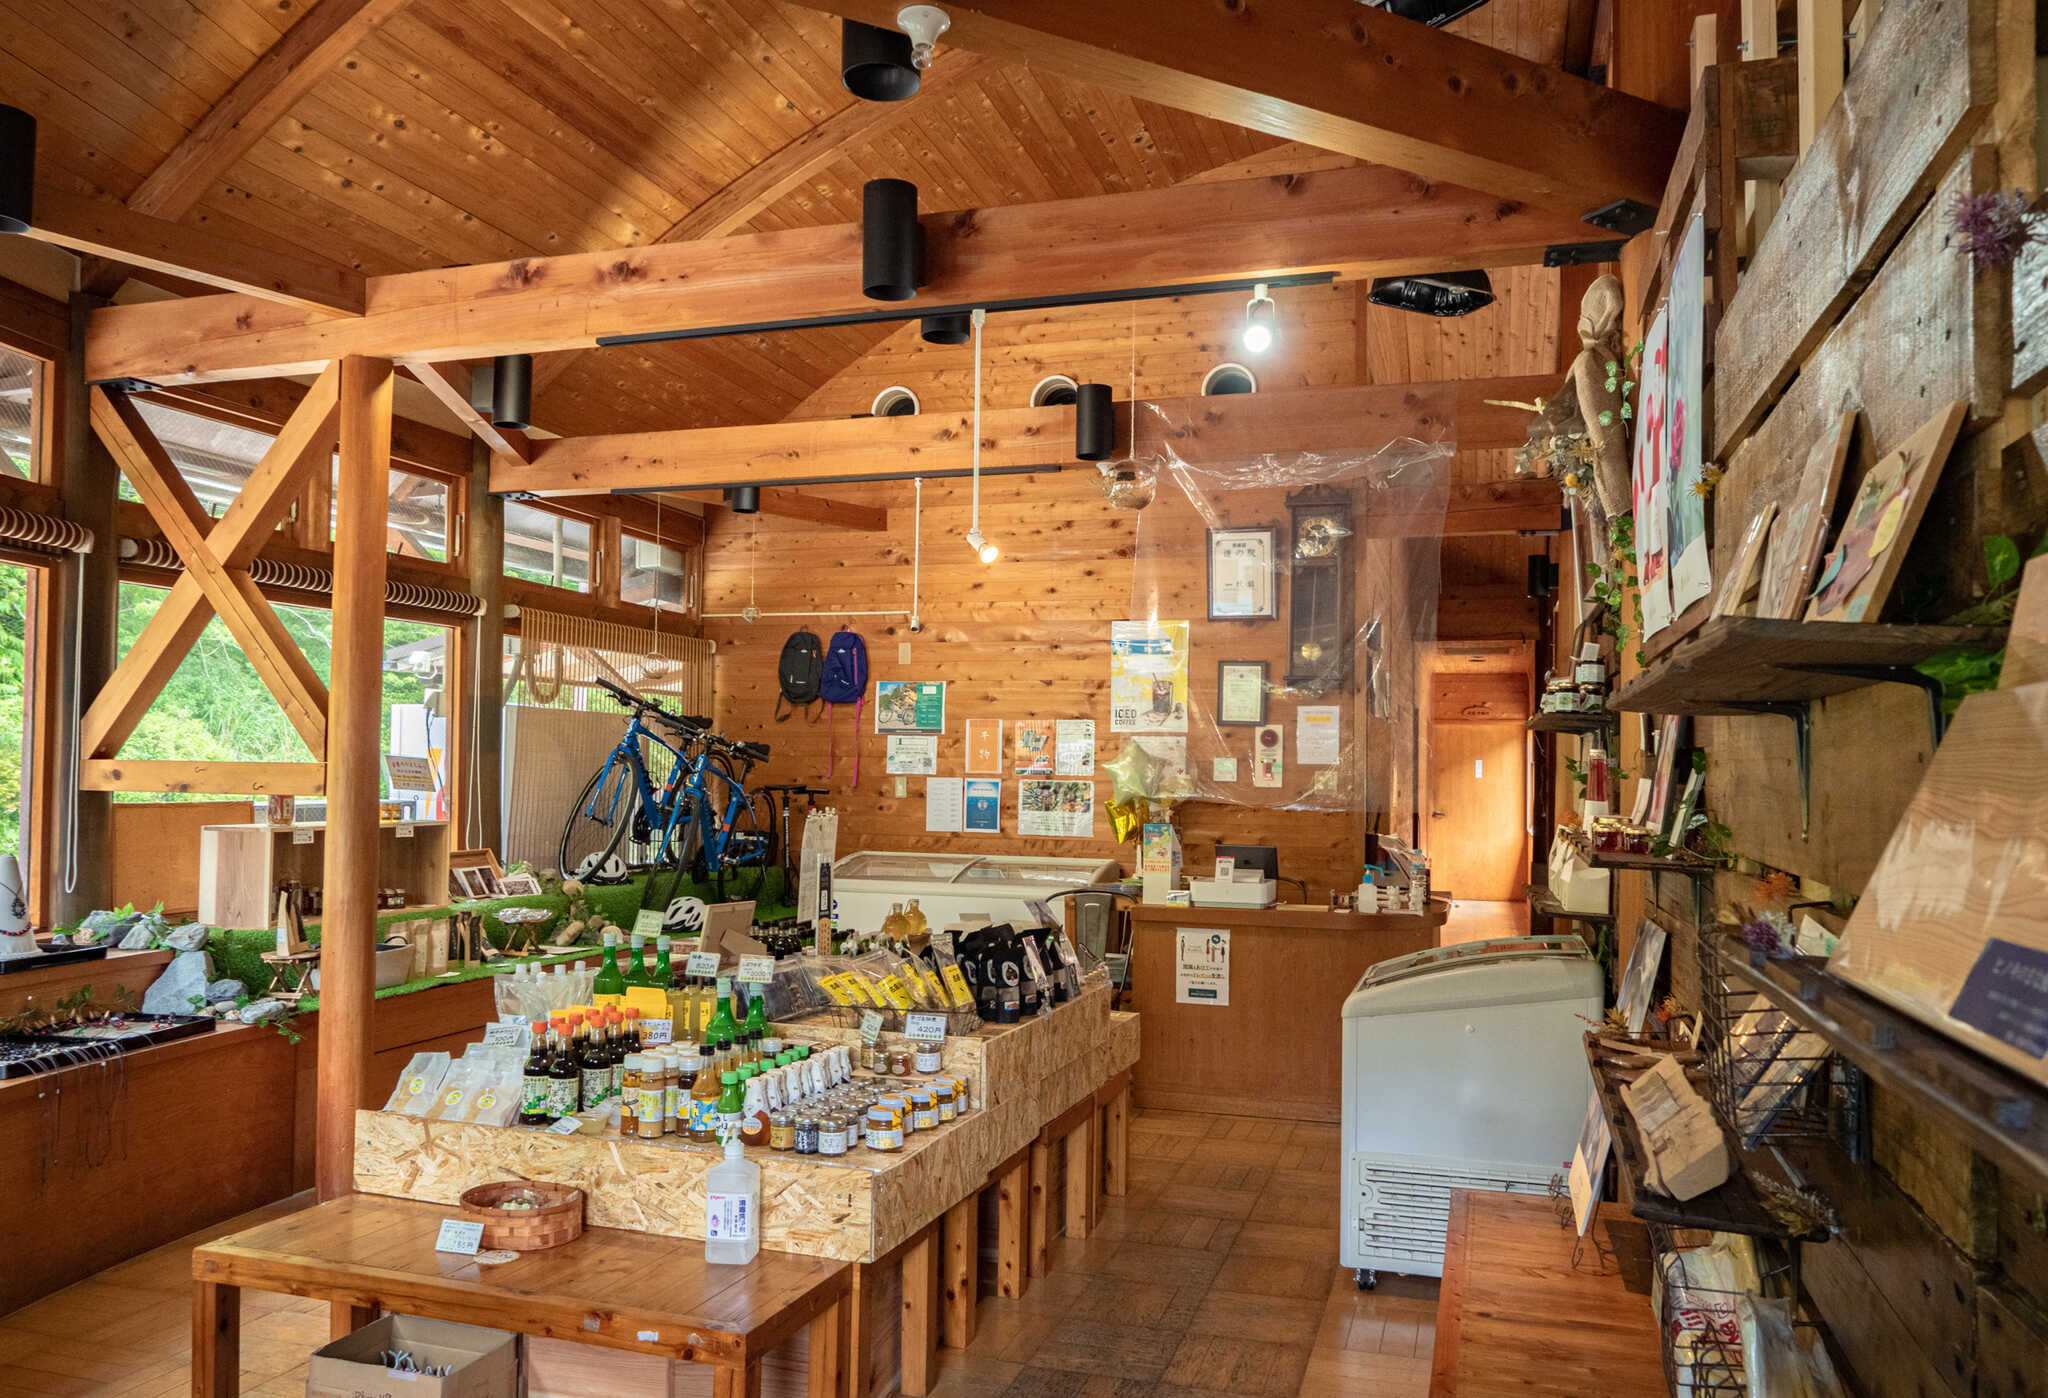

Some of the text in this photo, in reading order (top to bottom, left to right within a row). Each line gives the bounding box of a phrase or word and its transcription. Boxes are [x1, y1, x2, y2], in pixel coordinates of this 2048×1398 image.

[1114, 709, 1137, 719] ICED
[917, 1025, 942, 1034] 420円
[642, 1031, 668, 1040] 380円
